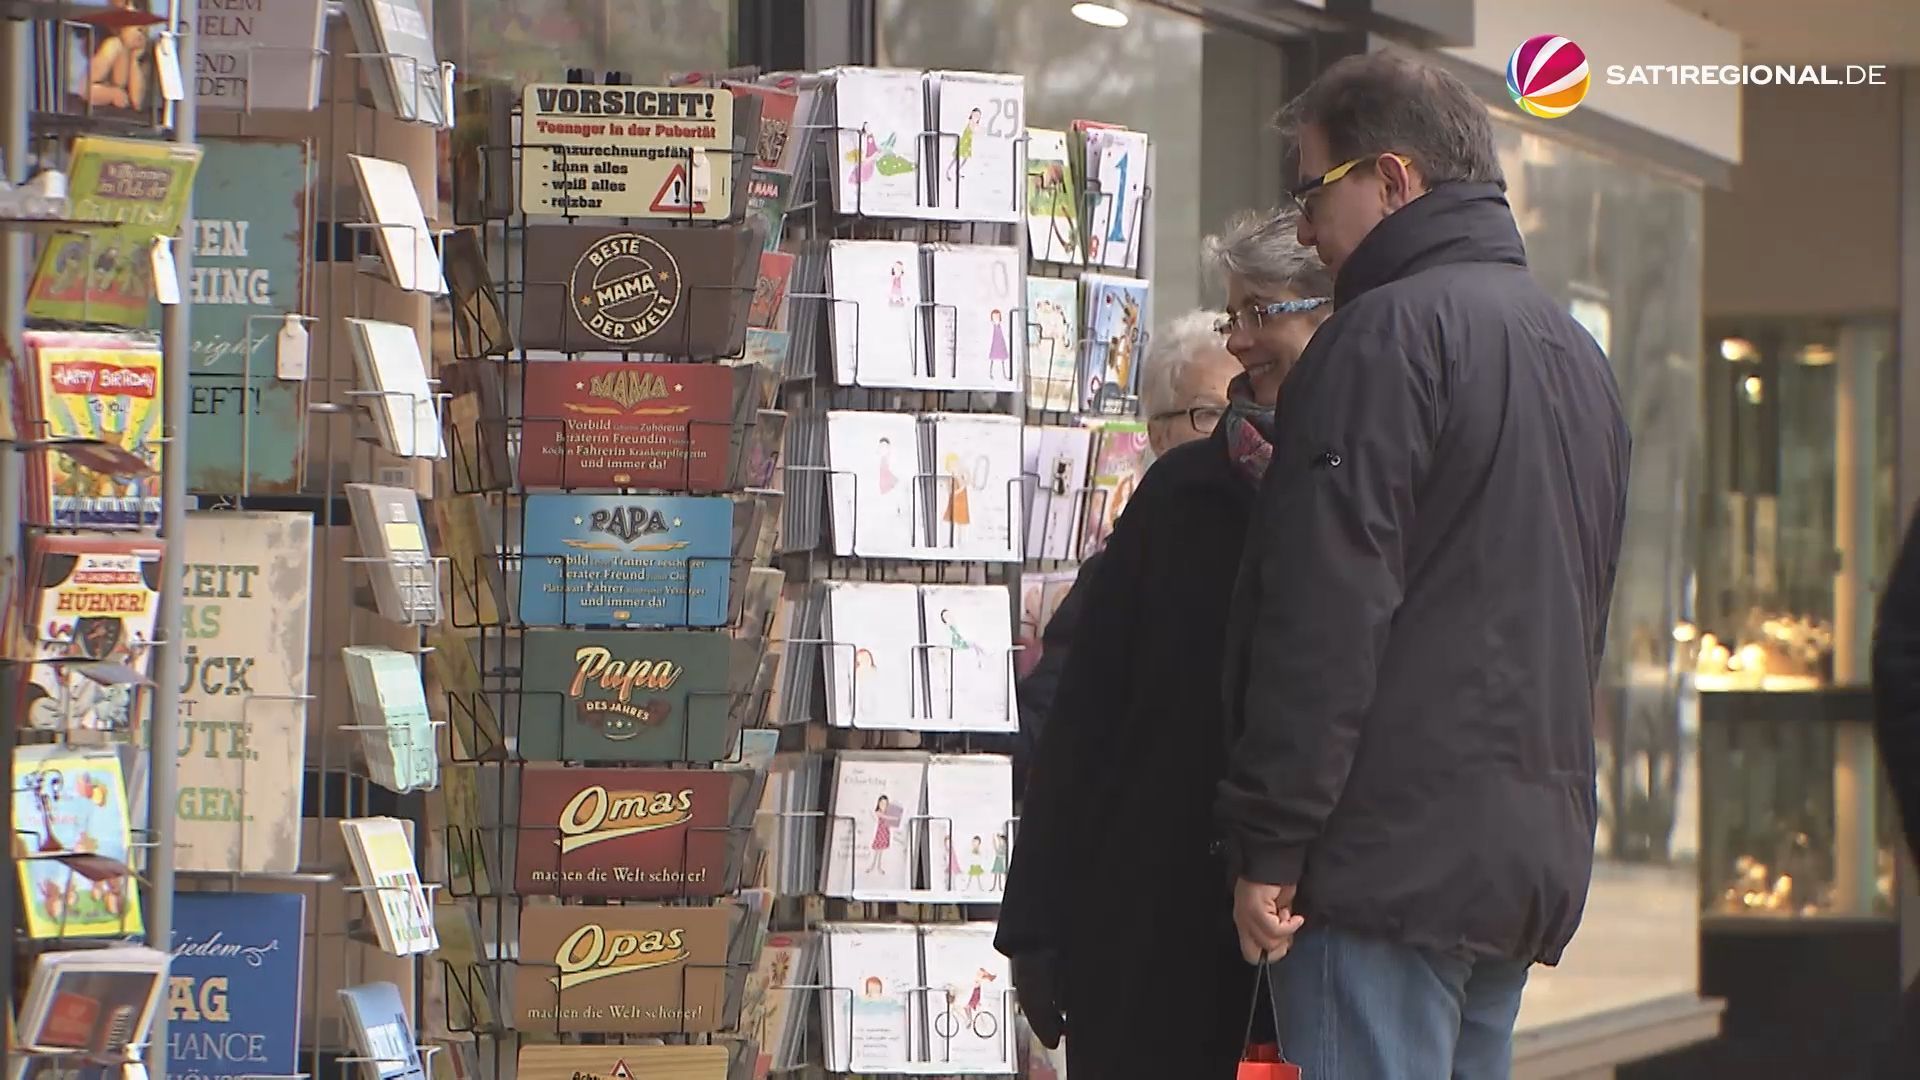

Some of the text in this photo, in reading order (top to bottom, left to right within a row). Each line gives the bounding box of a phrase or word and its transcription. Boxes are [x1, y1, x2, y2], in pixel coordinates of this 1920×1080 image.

[536, 88, 715, 118] VORSICHT!
[986, 98, 1020, 139] 29
[536, 119, 716, 139] Teenager in der Pubertät
[552, 160, 628, 175] kann alles
[551, 178, 626, 192] weiß alles
[551, 196, 603, 208] reizbar
[588, 238, 641, 267] BESTE
[596, 274, 656, 306] MAMA
[589, 295, 673, 338] DER WELT
[589, 369, 670, 409] MAMA
[567, 418, 611, 430] Vorbild
[555, 431, 609, 443] Braterin
[612, 432, 667, 445] Freundin
[542, 446, 574, 456] Köchn
[576, 443, 625, 456] Fahrerin
[580, 456, 667, 470] und immer da!
[590, 505, 669, 544] PAPA
[546, 554, 590, 566] Vobild
[613, 555, 655, 568] Trainer
[603, 567, 645, 580] Freund
[587, 581, 624, 594] Fahrer
[57, 587, 147, 612] HÜHNER!
[580, 594, 667, 609] und immer da!
[569, 646, 683, 703] Papa
[586, 701, 650, 721] DES JAHRES
[559, 786, 694, 836] Omas
[587, 866, 607, 882] die
[613, 866, 644, 882] Welt
[555, 924, 686, 974] Opas
[583, 1004, 603, 1019] die
[609, 1004, 641, 1019] Welt
